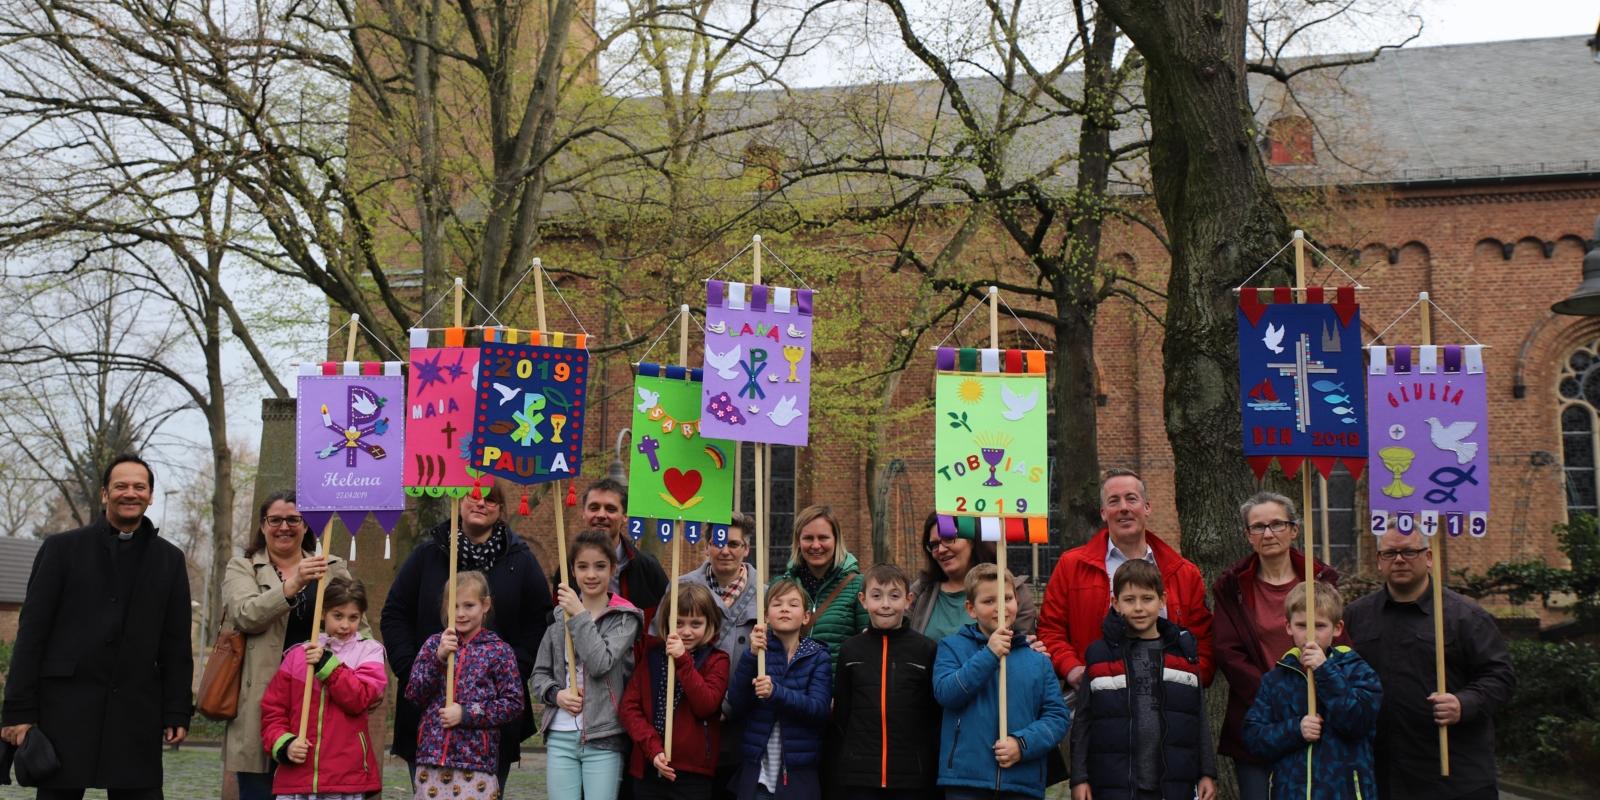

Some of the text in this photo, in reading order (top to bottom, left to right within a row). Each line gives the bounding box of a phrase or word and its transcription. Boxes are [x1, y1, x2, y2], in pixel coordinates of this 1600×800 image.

[728, 320, 779, 342] LANA
[495, 358, 571, 382] 2019
[1387, 383, 1464, 408] GIULIA
[412, 398, 459, 419] MAIA
[482, 446, 569, 477] PAULA
[321, 472, 382, 487] Helena
[956, 496, 1027, 513] 2019
[632, 520, 726, 538] 2019
